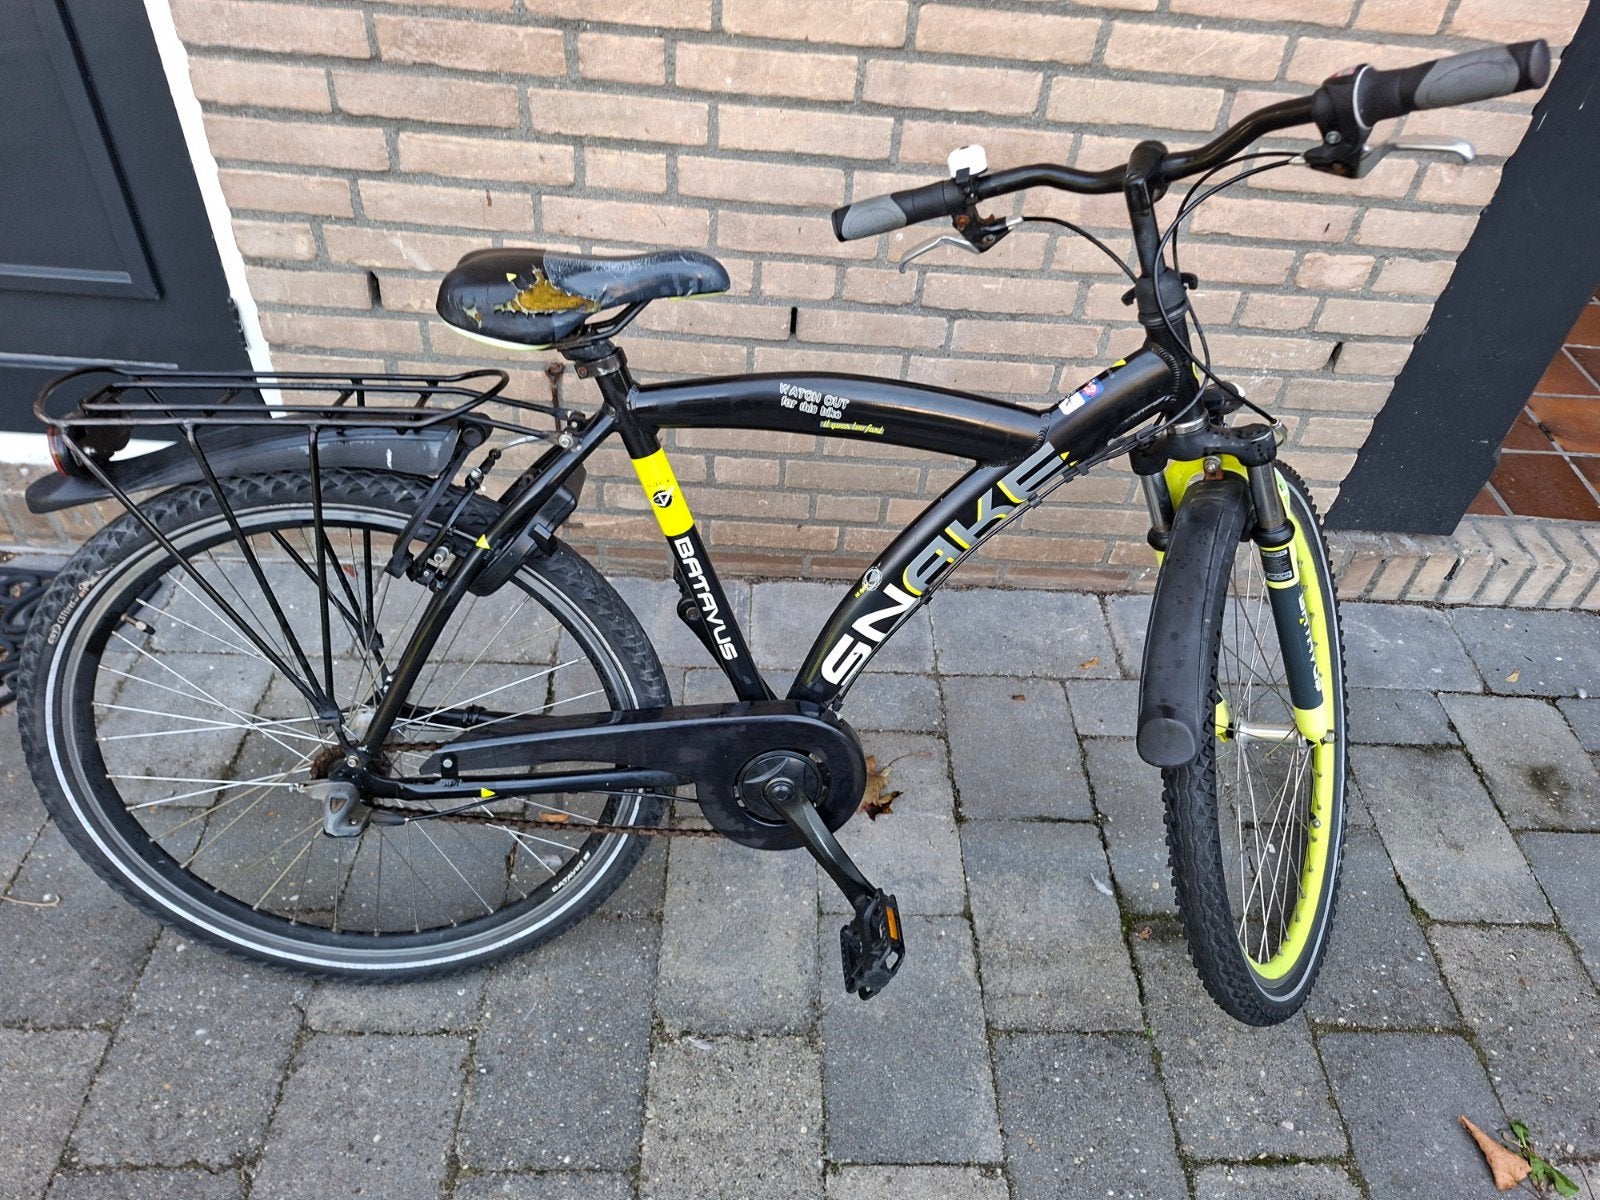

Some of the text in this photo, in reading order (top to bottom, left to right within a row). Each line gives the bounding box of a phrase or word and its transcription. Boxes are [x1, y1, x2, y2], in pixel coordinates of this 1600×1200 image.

[779, 382, 850, 409] WATCH OUT
[780, 396, 797, 409] for
[799, 401, 818, 415] this
[820, 441, 1078, 687] SNAKE
[674, 535, 738, 661] BATAVUS
[551, 859, 585, 893] BATAVUS
